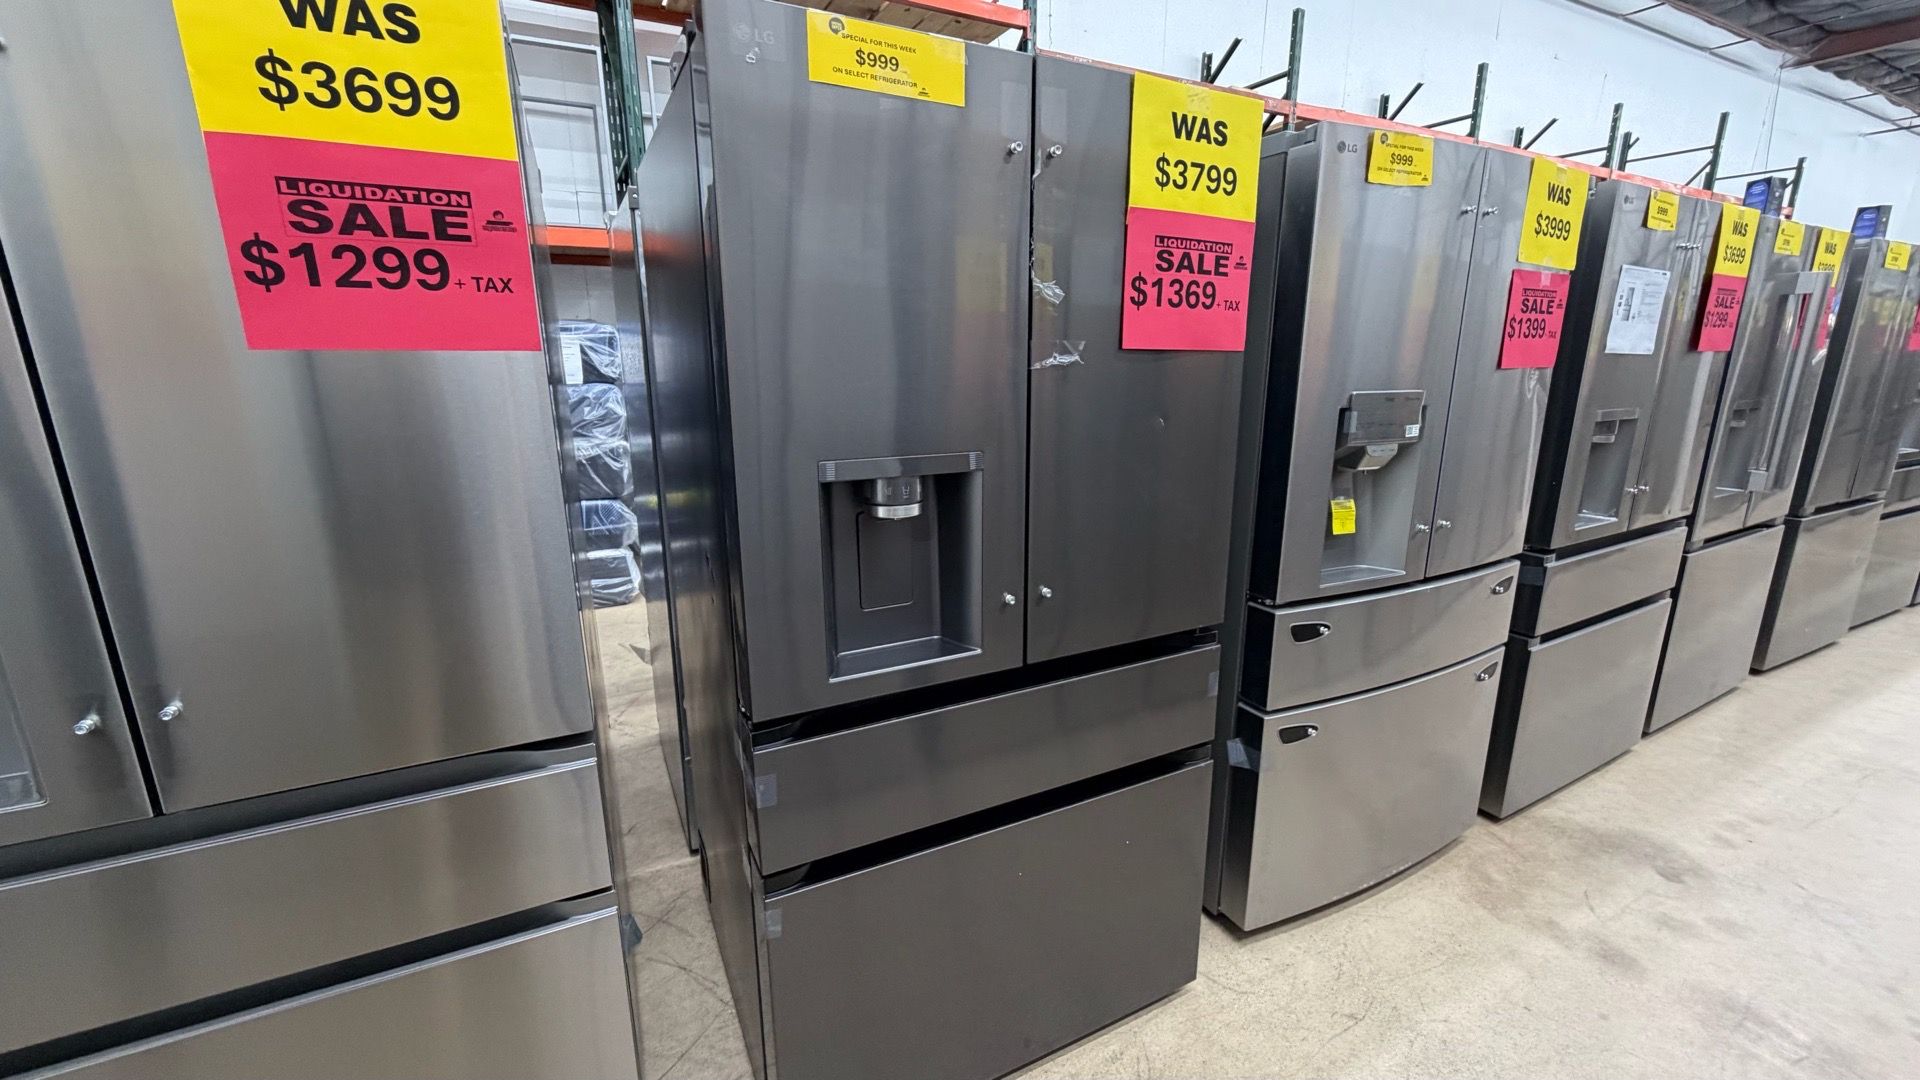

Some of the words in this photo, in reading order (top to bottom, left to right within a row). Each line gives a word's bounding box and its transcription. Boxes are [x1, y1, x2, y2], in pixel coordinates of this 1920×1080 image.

[279, 0, 421, 43] WAS
[754, 28, 774, 45] LG
[841, 32, 869, 45] SPECIAL
[869, 38, 883, 48] FOR
[883, 41, 898, 50] THIS
[899, 44, 917, 54] WEEK
[855, 47, 900, 72] $999
[254, 48, 460, 121] $3699
[832, 66, 843, 74] ON
[844, 68, 869, 80] SELECT
[870, 72, 918, 89] REFRIGERATOR
[1171, 111, 1228, 147] WAS
[1347, 143, 1358, 153] LG
[1390, 152, 1414, 167] $999
[1155, 152, 1237, 196] $3799
[278, 179, 470, 208] LIQUIDATION
[1547, 181, 1572, 206] WAS
[287, 199, 472, 243] SALE
[1534, 210, 1571, 242] $3999
[1732, 220, 1749, 237] WAS
[1155, 236, 1233, 254] LIQUIDATION
[1723, 242, 1746, 264] $3699
[240, 233, 450, 293] $1299
[454, 278, 467, 290] +
[471, 276, 514, 294] TAX
[1155, 249, 1230, 277] SALE
[1129, 272, 1217, 311] $1369
[1223, 299, 1240, 312] TAX
[1714, 295, 1735, 309] SALE
[1520, 298, 1555, 315] SALE
[1507, 313, 1547, 342] $1399
